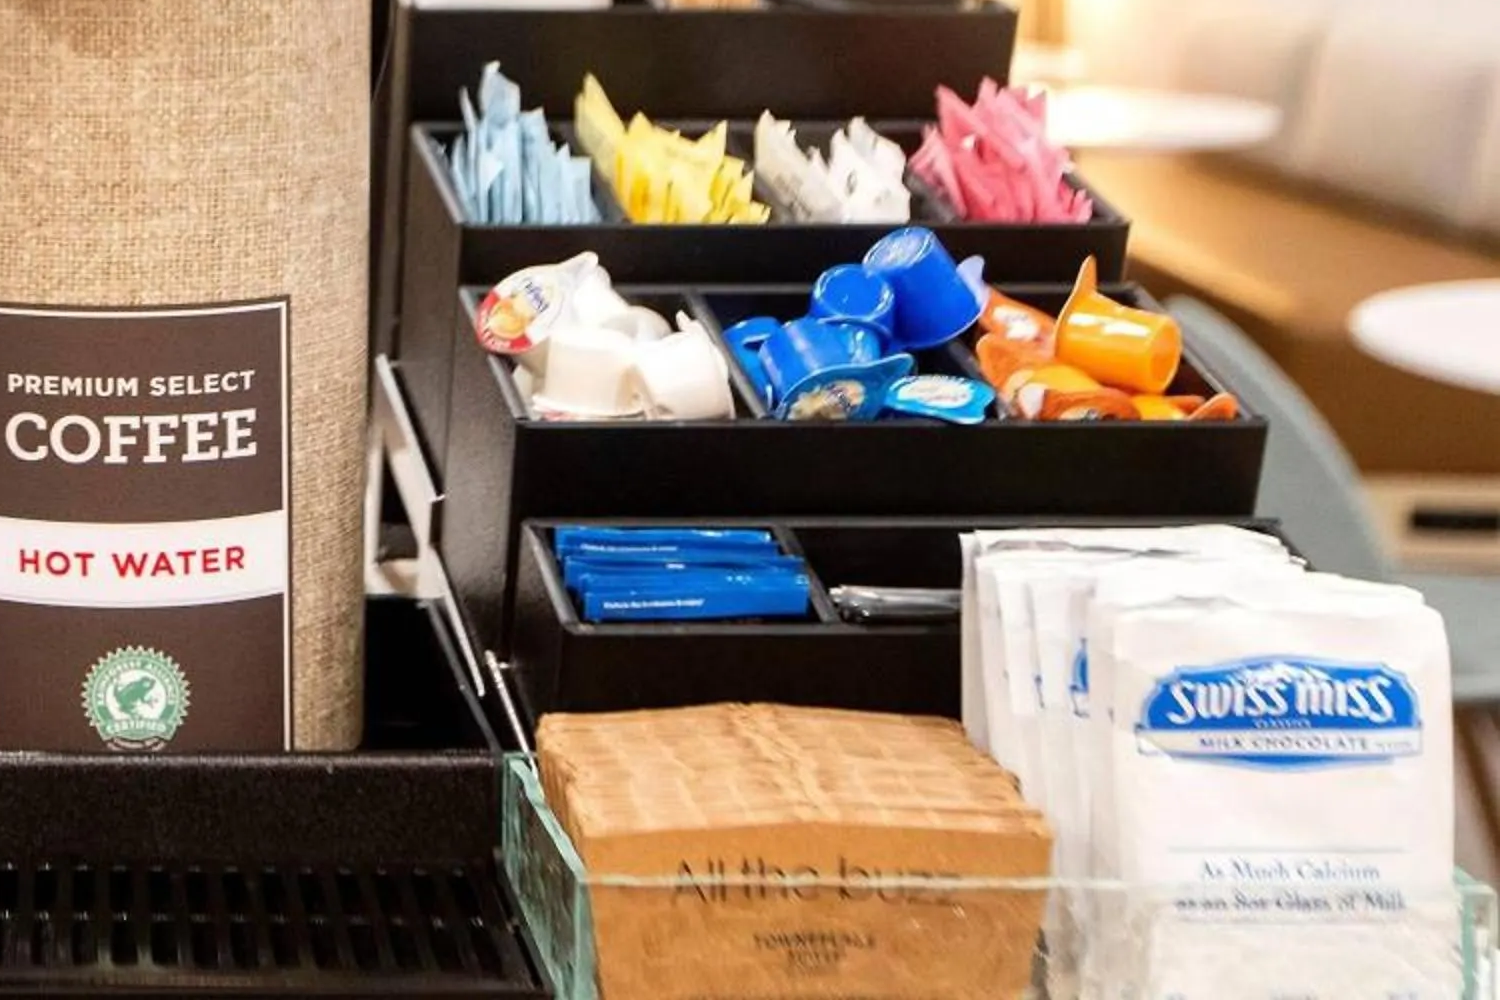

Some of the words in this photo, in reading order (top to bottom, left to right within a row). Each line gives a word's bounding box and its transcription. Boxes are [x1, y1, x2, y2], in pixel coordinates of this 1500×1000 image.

[7, 373, 138, 397] PREMIUM
[149, 370, 255, 396] SELECT
[5, 408, 257, 464] COFFEE
[19, 549, 94, 577] HOT
[112, 546, 245, 578] WATER
[672, 856, 727, 903] All
[740, 856, 820, 901] the
